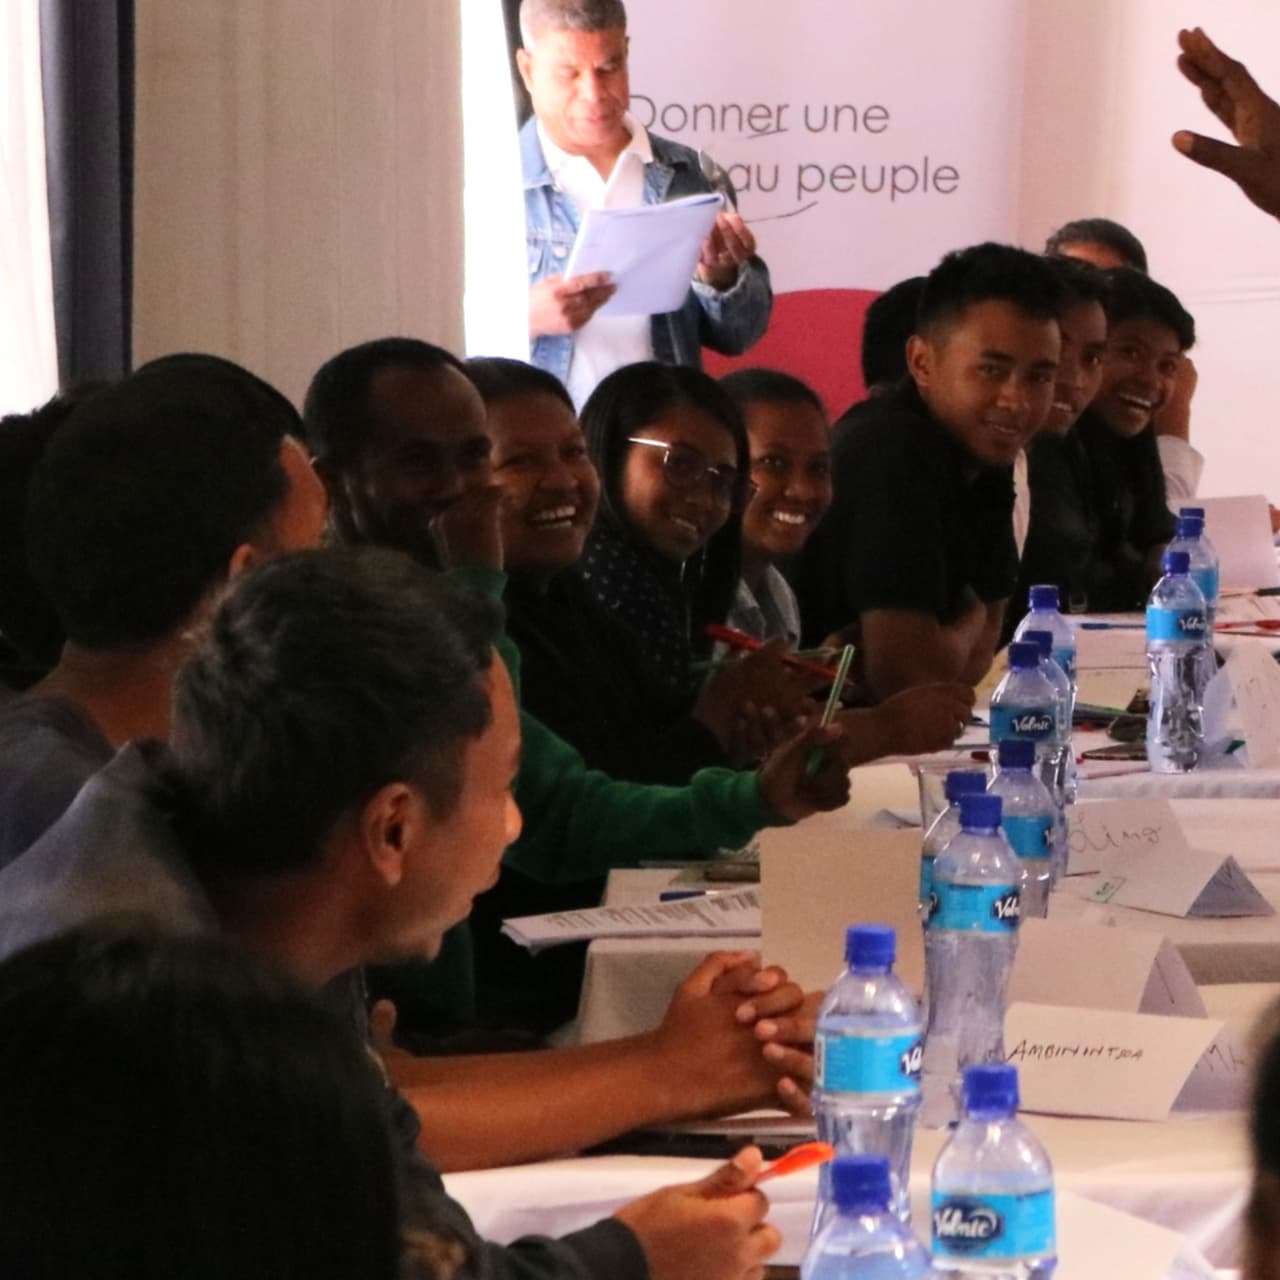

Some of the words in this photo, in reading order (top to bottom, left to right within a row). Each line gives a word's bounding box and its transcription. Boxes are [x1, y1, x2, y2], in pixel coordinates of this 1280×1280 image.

[628, 94, 790, 134] Donner
[804, 103, 890, 134] une
[727, 163, 779, 193] au
[797, 155, 961, 202] peuple
